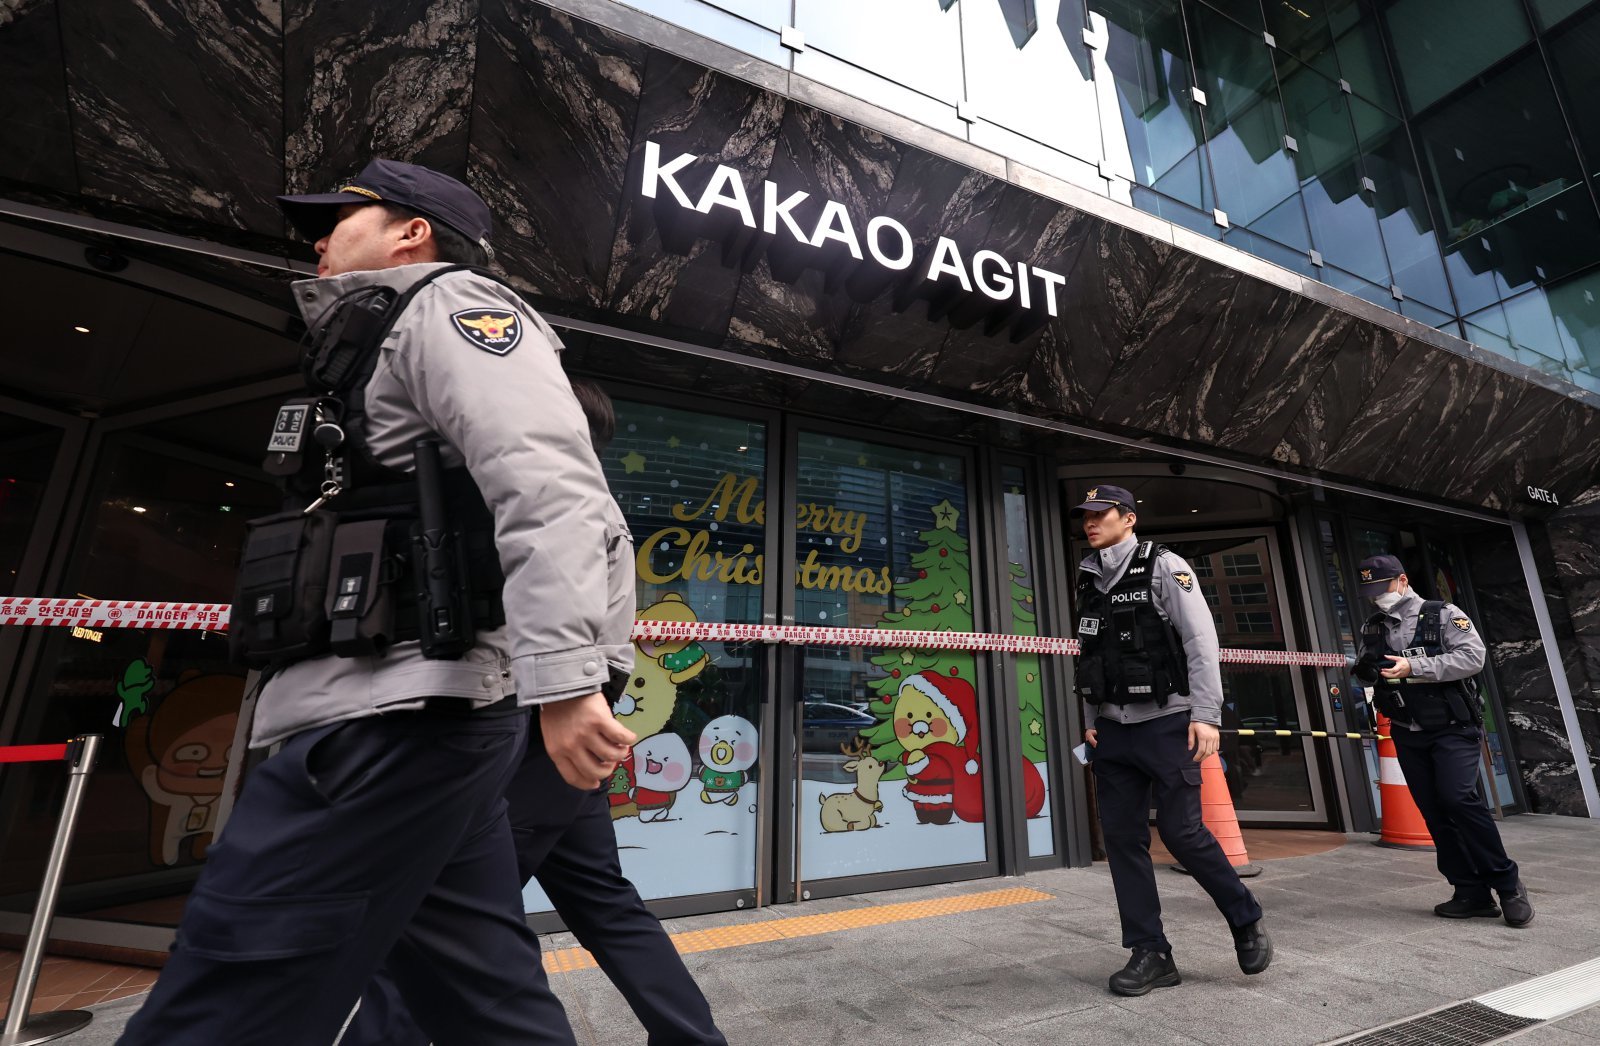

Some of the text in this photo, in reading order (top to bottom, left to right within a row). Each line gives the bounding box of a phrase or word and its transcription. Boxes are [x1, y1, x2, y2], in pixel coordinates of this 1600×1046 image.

[642, 141, 1066, 317] KAKAO AGIT
[272, 435, 297, 446] POLICE
[1527, 485, 1559, 506] GATE 4
[672, 472, 867, 553] Merry
[636, 527, 893, 595] Christmas
[1111, 591, 1147, 604] POLICE
[39, 606, 93, 618] 안전제일
[137, 610, 188, 620] DANGER
[197, 611, 219, 621] 위험
[660, 627, 691, 635] DANGER
[784, 631, 811, 639] DANGER
